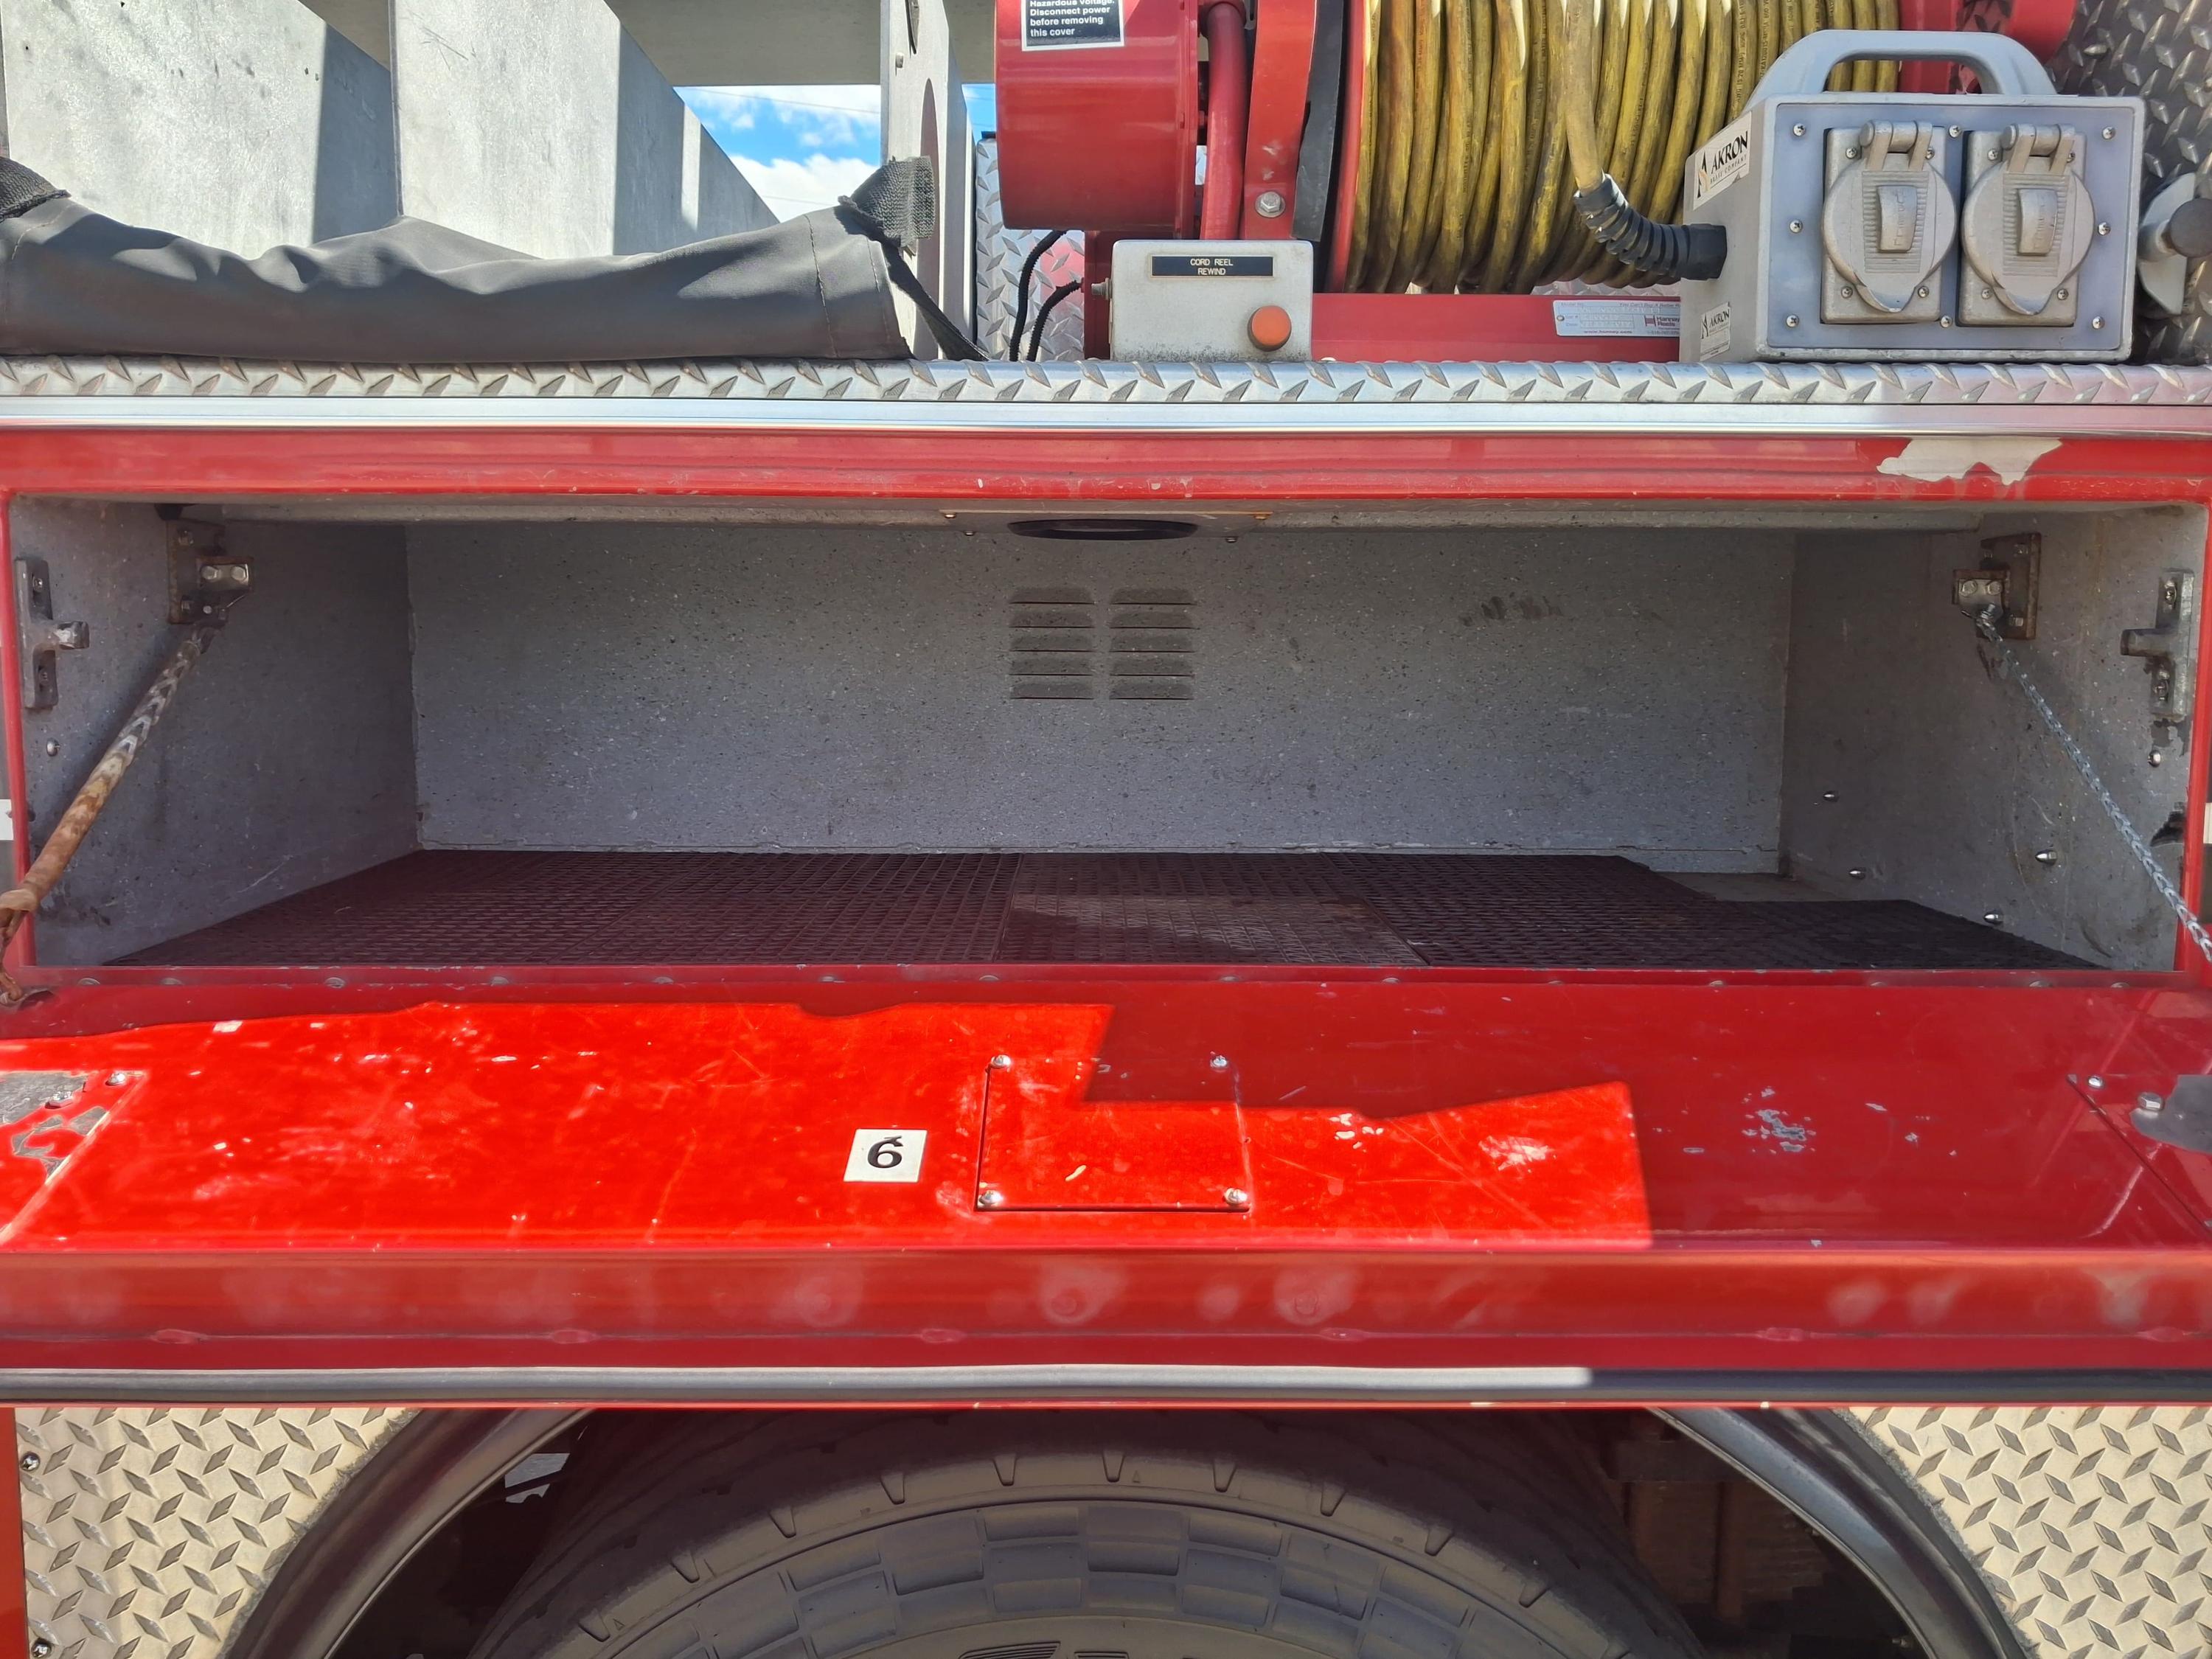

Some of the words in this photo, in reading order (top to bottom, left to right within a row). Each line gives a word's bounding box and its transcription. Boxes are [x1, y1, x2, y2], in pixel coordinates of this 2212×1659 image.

[1030, 7, 1080, 16] Disconnect
[1082, 7, 1110, 15] power
[1061, 16, 1104, 25] removing
[1030, 28, 1047, 37] this
[1049, 27, 1075, 36] cover
[1711, 131, 1748, 174] AKRON
[1724, 155, 1747, 174] COMPANY
[1190, 258, 1211, 266] CORD
[1214, 258, 1234, 266] REEL
[867, 1135, 903, 1169] 6
